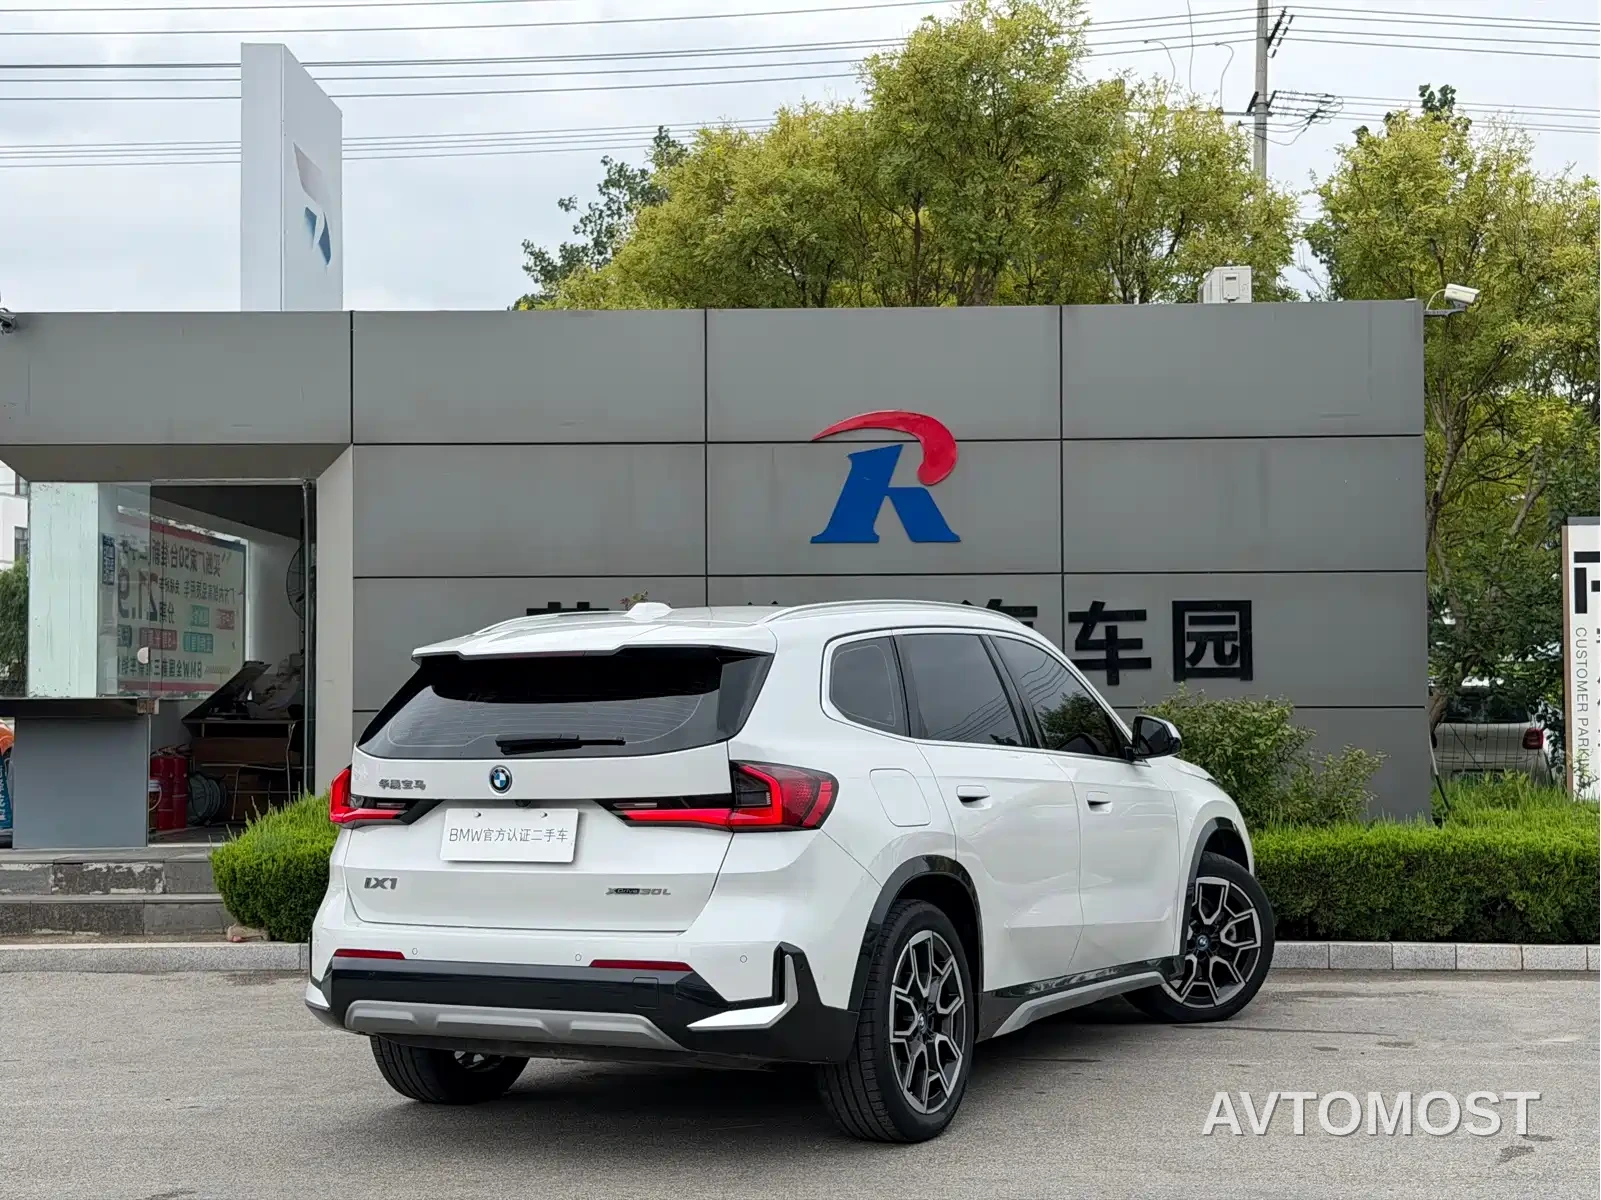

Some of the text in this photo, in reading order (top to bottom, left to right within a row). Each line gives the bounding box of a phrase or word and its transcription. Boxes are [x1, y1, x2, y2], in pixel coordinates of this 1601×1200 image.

[1575, 627, 1588, 713] CUSTOMER
[379, 779, 426, 790] 华晨宝马
[449, 828, 568, 842] BMW官方认证二手车
